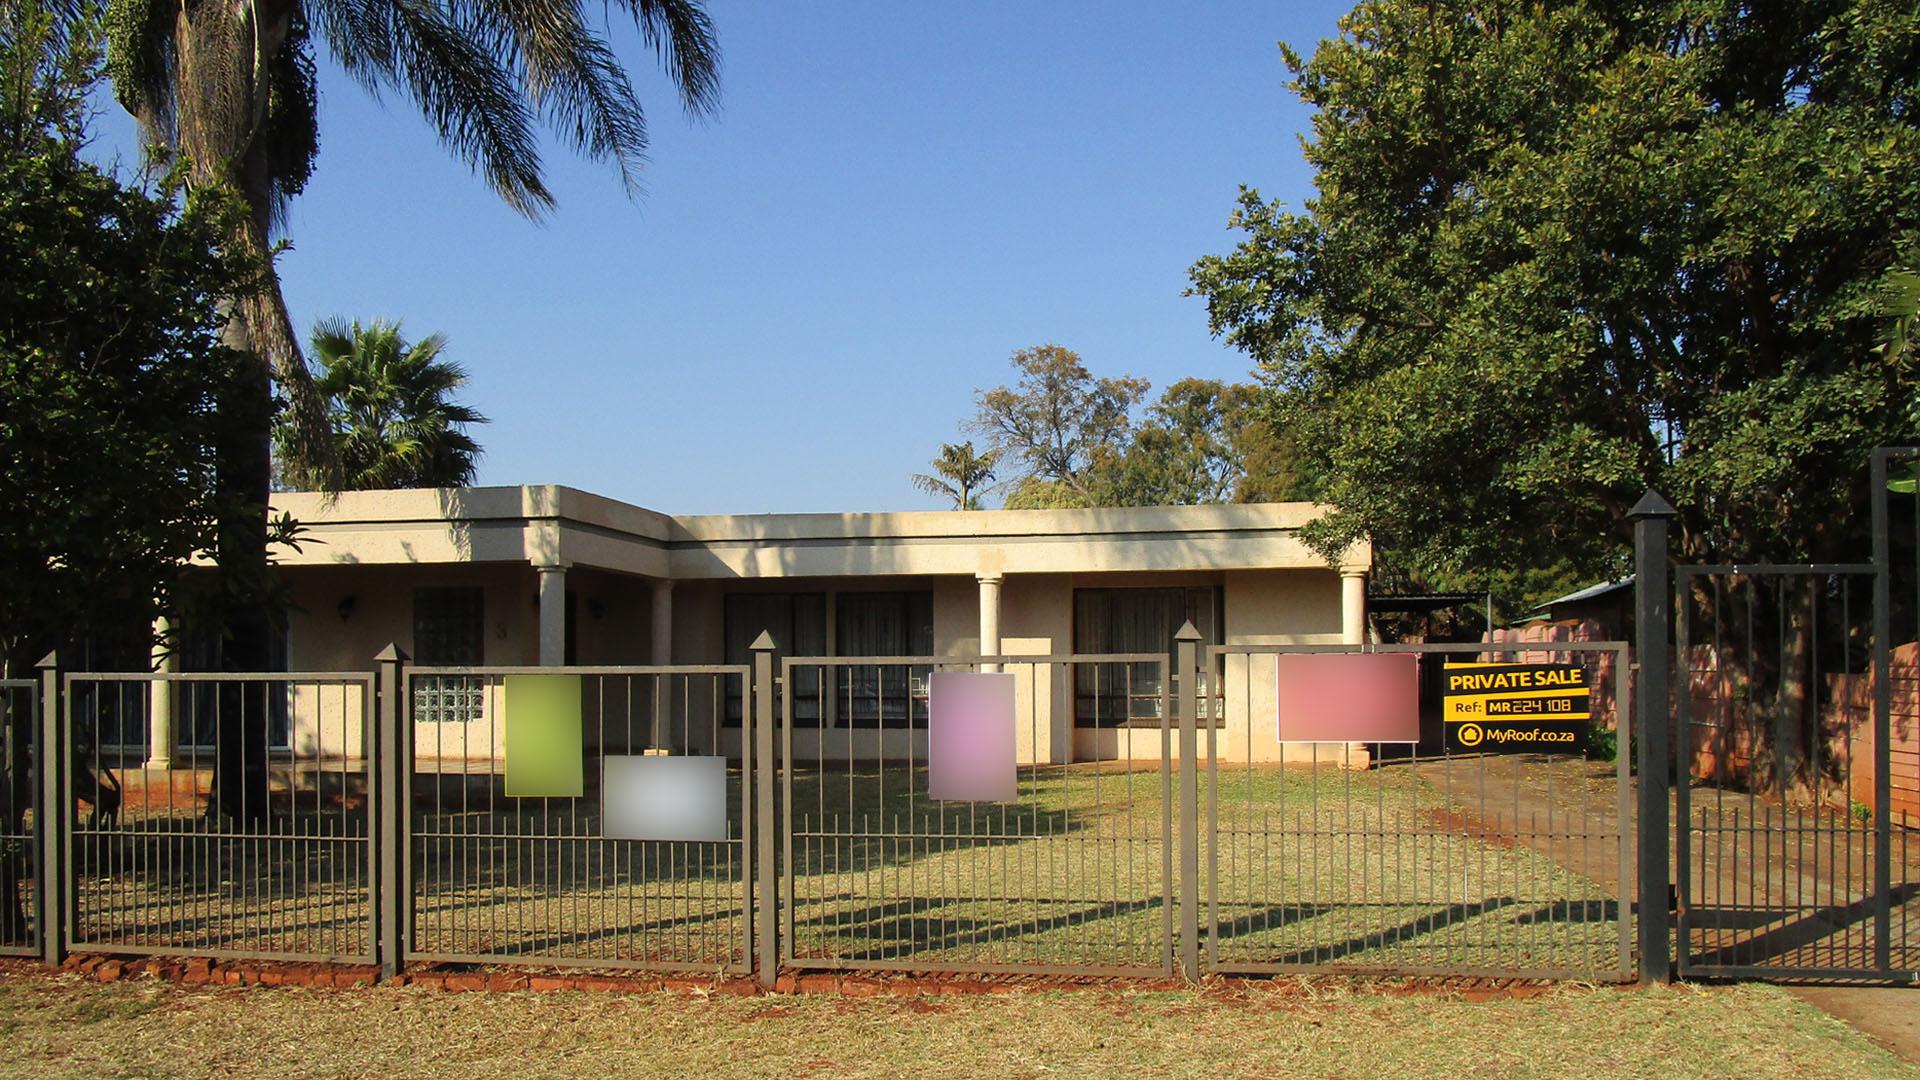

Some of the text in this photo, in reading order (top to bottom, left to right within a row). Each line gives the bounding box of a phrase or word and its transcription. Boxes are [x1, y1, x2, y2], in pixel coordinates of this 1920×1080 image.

[1450, 669, 1583, 690] PRIVATE SALE
[1455, 702, 1482, 713] Ref:
[1546, 699, 1571, 711] 108
[1486, 728, 1575, 743] MyRoof.co.za
